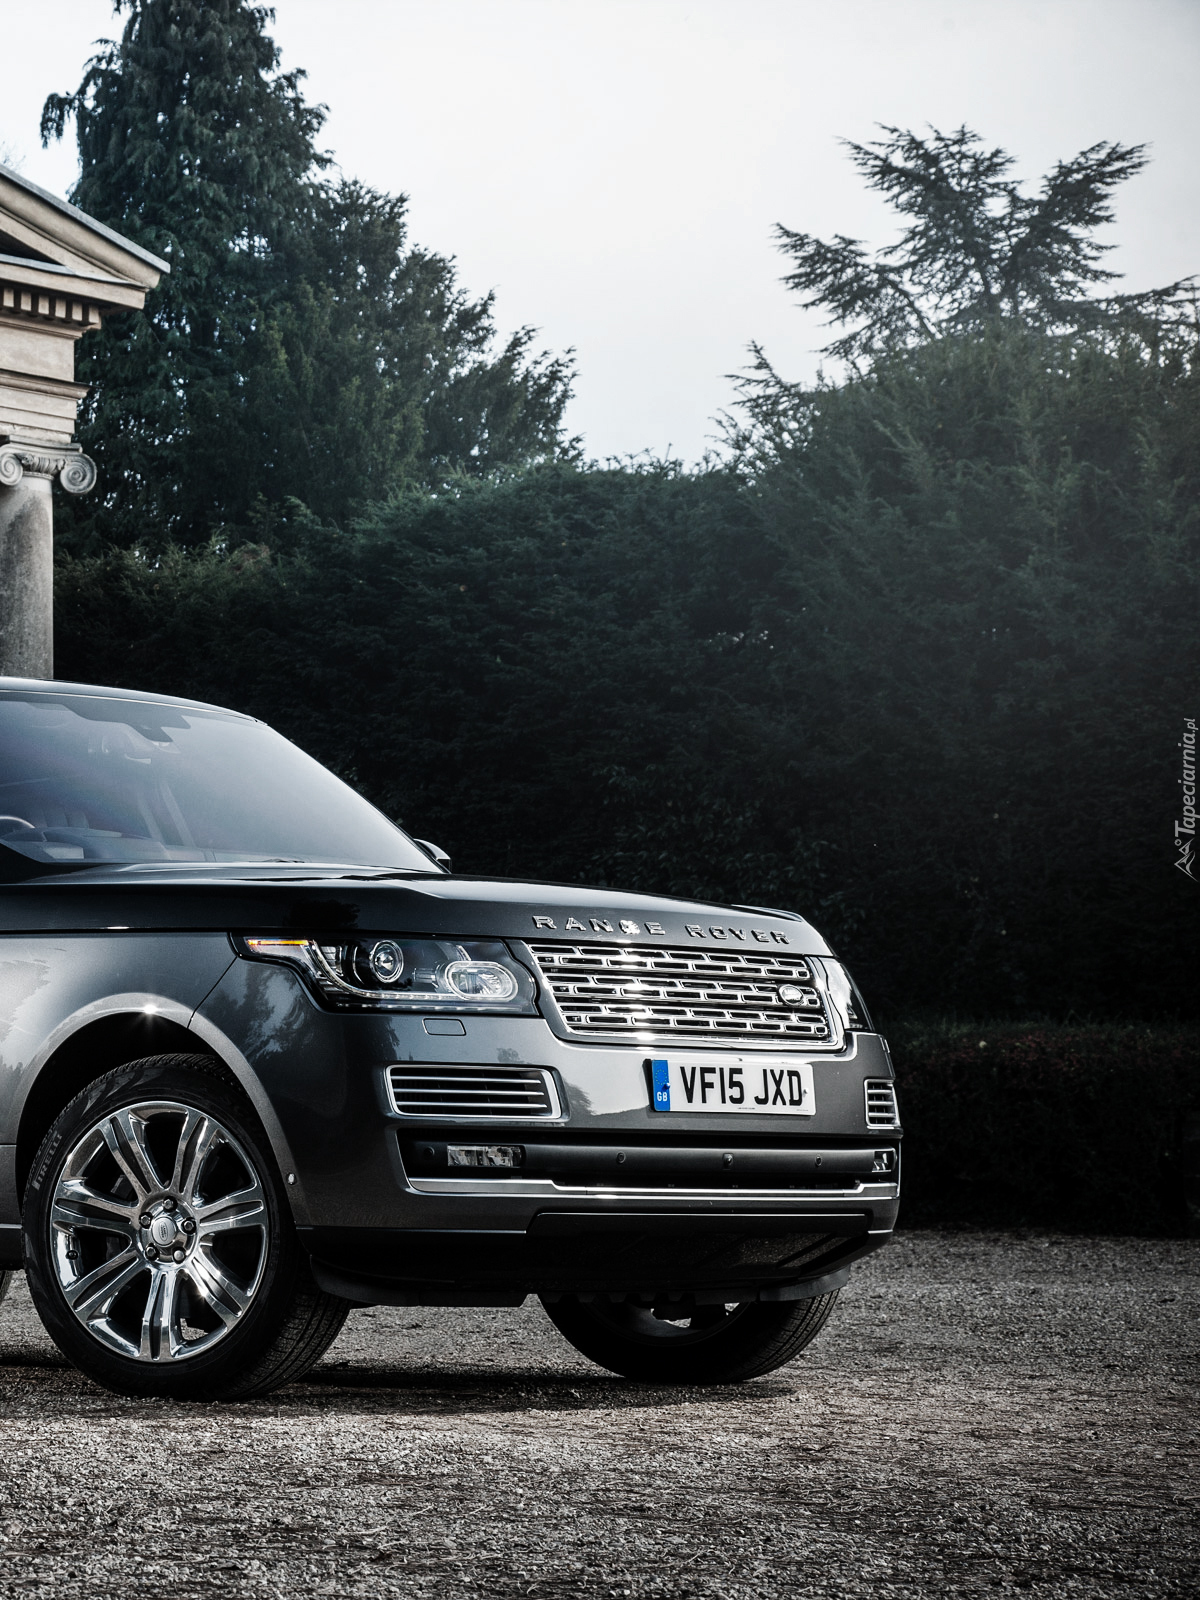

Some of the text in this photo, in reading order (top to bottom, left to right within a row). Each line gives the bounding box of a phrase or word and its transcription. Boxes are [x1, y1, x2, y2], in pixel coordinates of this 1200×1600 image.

[532, 915, 791, 945] RANGE ROVER
[656, 1091, 668, 1102] GB
[679, 1066, 803, 1106] VF15 JXD
[31, 1130, 63, 1191] PIRELLI
